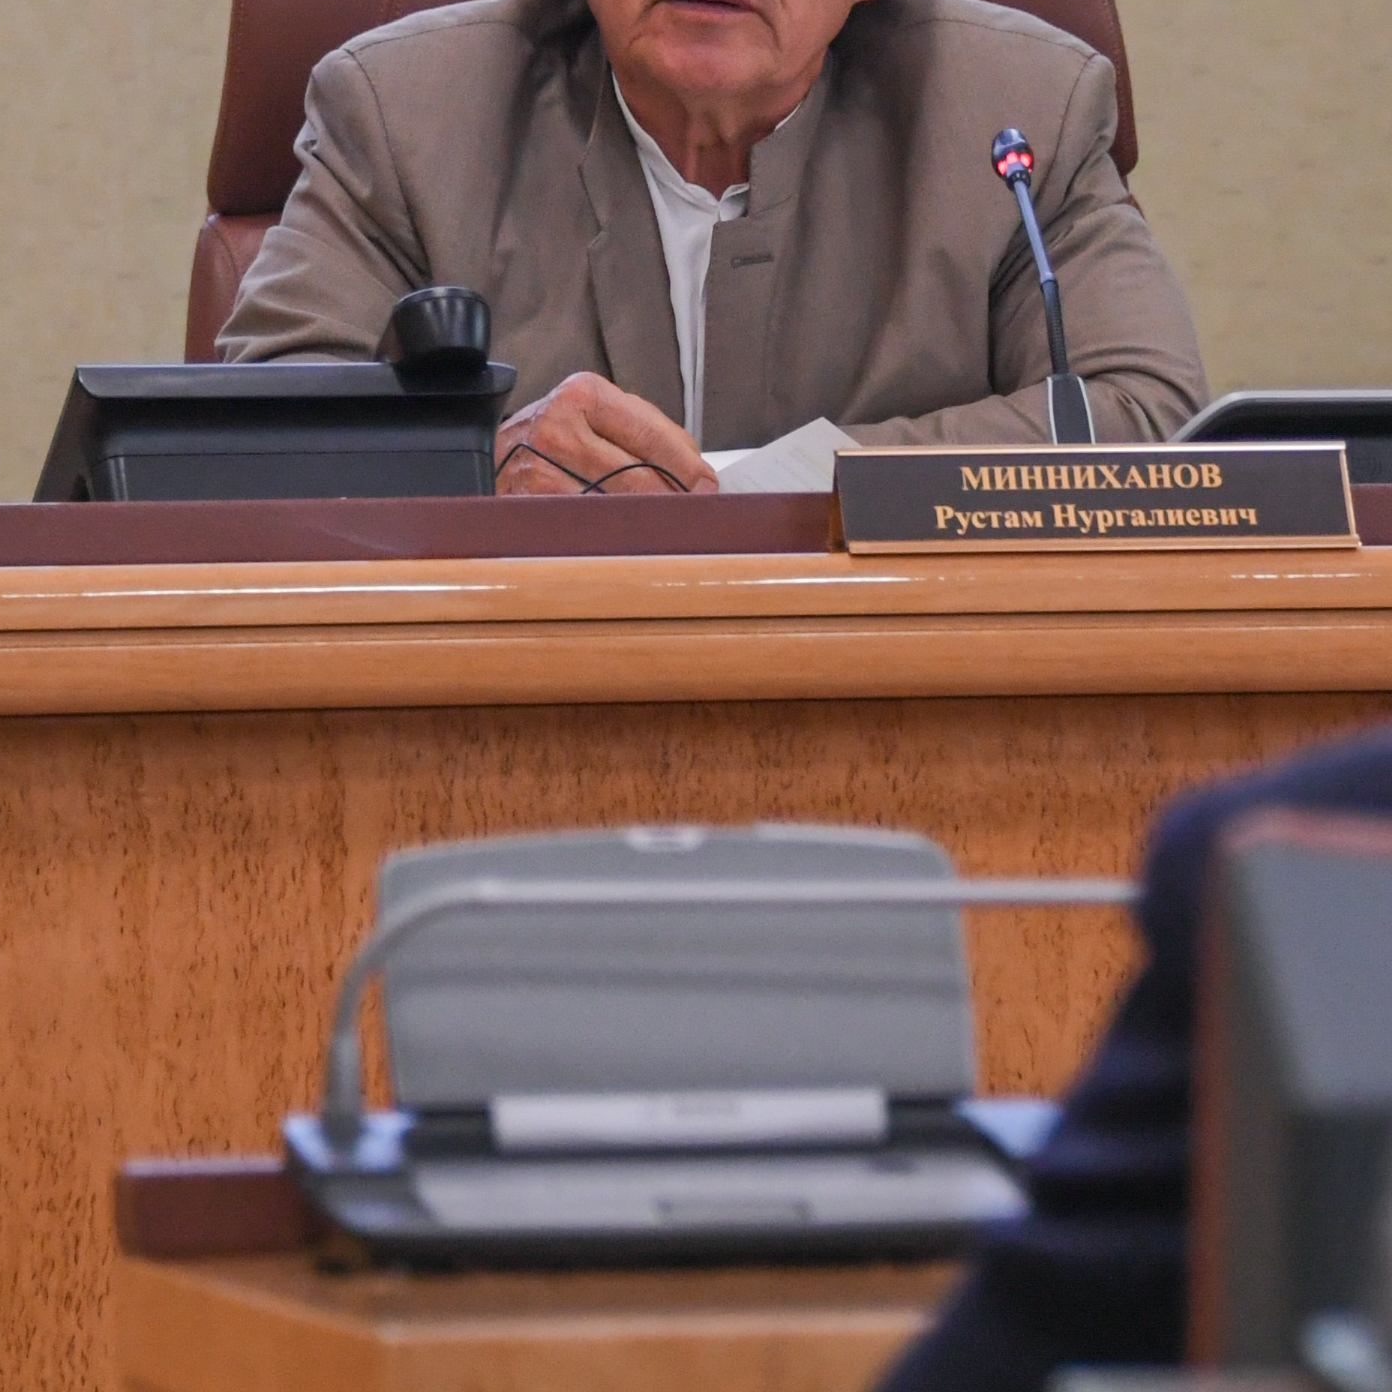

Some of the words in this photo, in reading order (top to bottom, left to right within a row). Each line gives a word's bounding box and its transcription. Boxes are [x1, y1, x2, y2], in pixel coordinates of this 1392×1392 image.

[960, 463, 1224, 491] МИННИХАНОВ
[934, 505, 1043, 535] Рустам
[1051, 503, 1258, 534] Нургалиевич
